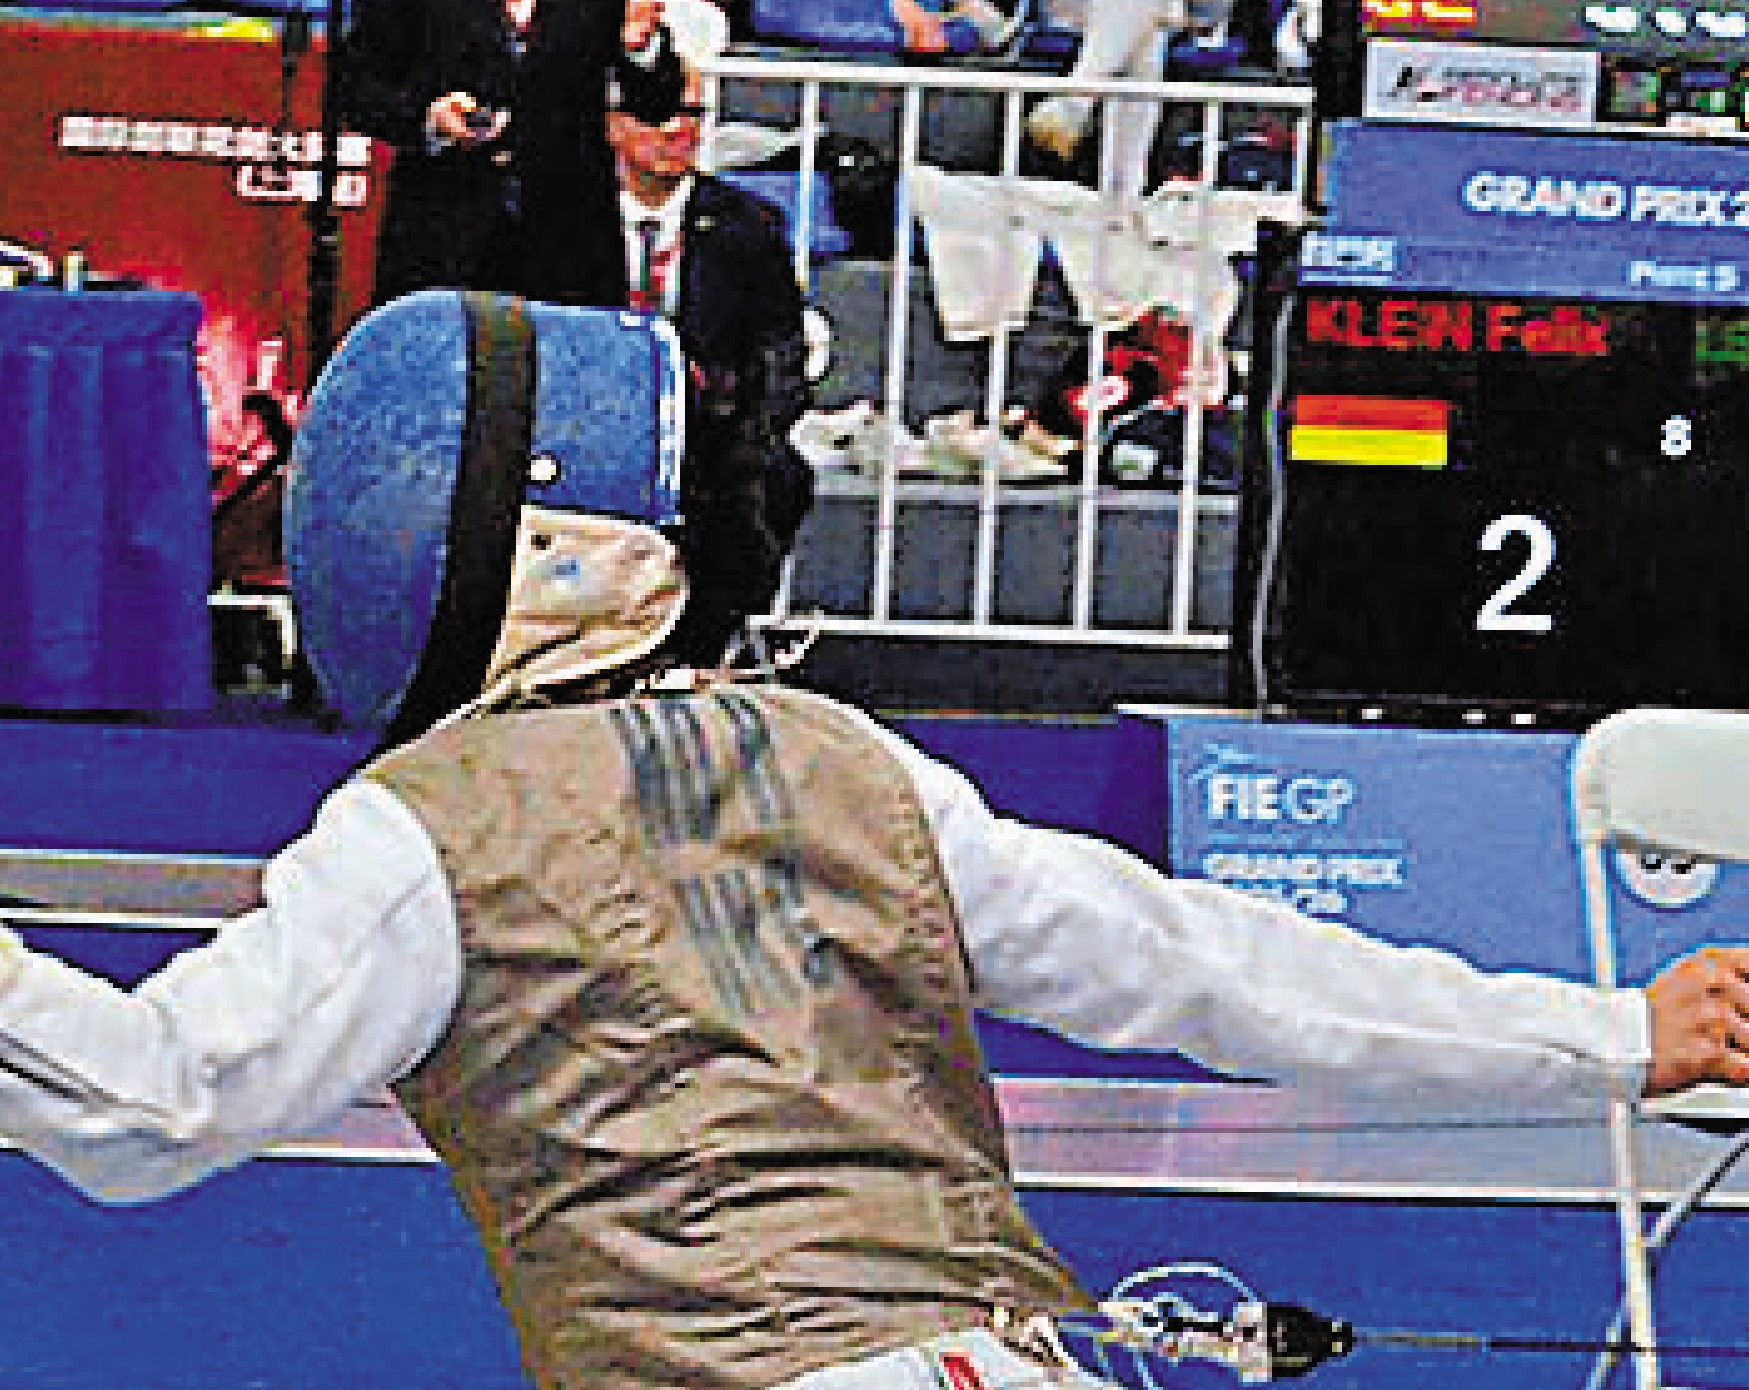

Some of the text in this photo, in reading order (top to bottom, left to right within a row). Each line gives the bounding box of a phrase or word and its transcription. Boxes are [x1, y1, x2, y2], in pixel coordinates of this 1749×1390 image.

[1461, 170, 1627, 220] GRAND
[1630, 184, 1728, 226] PRIX
[1305, 299, 1472, 352] KLEIN
[1475, 513, 1557, 633] 2
